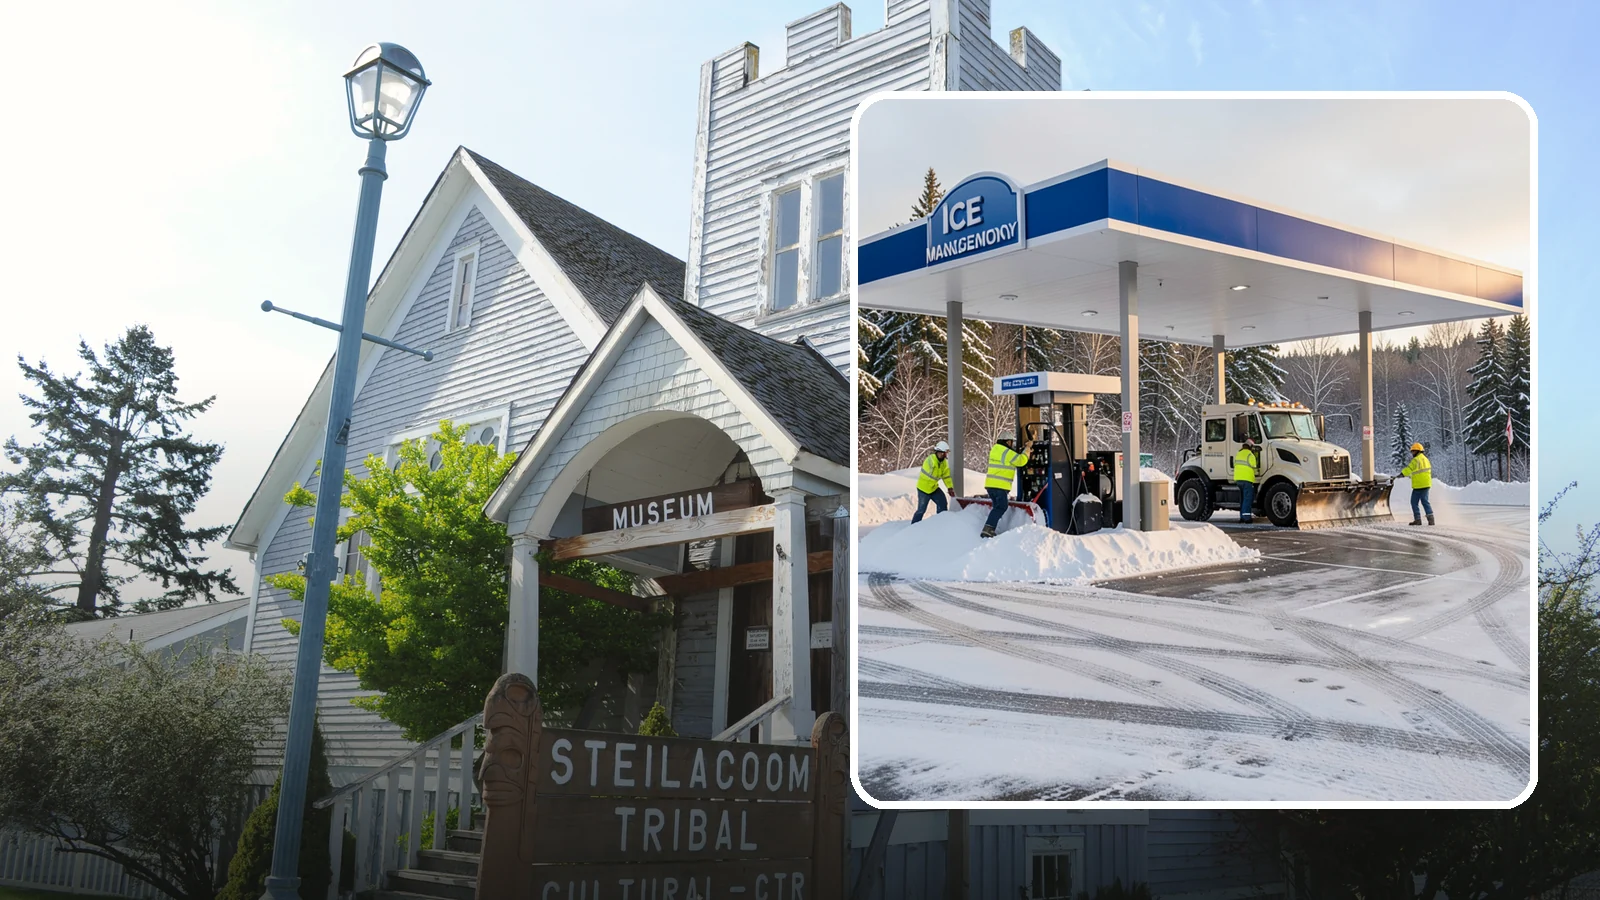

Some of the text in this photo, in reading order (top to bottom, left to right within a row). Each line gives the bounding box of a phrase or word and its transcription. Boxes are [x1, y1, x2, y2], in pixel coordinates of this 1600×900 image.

[943, 196, 984, 235] ICE
[613, 491, 713, 530] MUSEUM
[551, 738, 809, 792] STEILACOOM
[615, 807, 757, 852] TRIBAL
